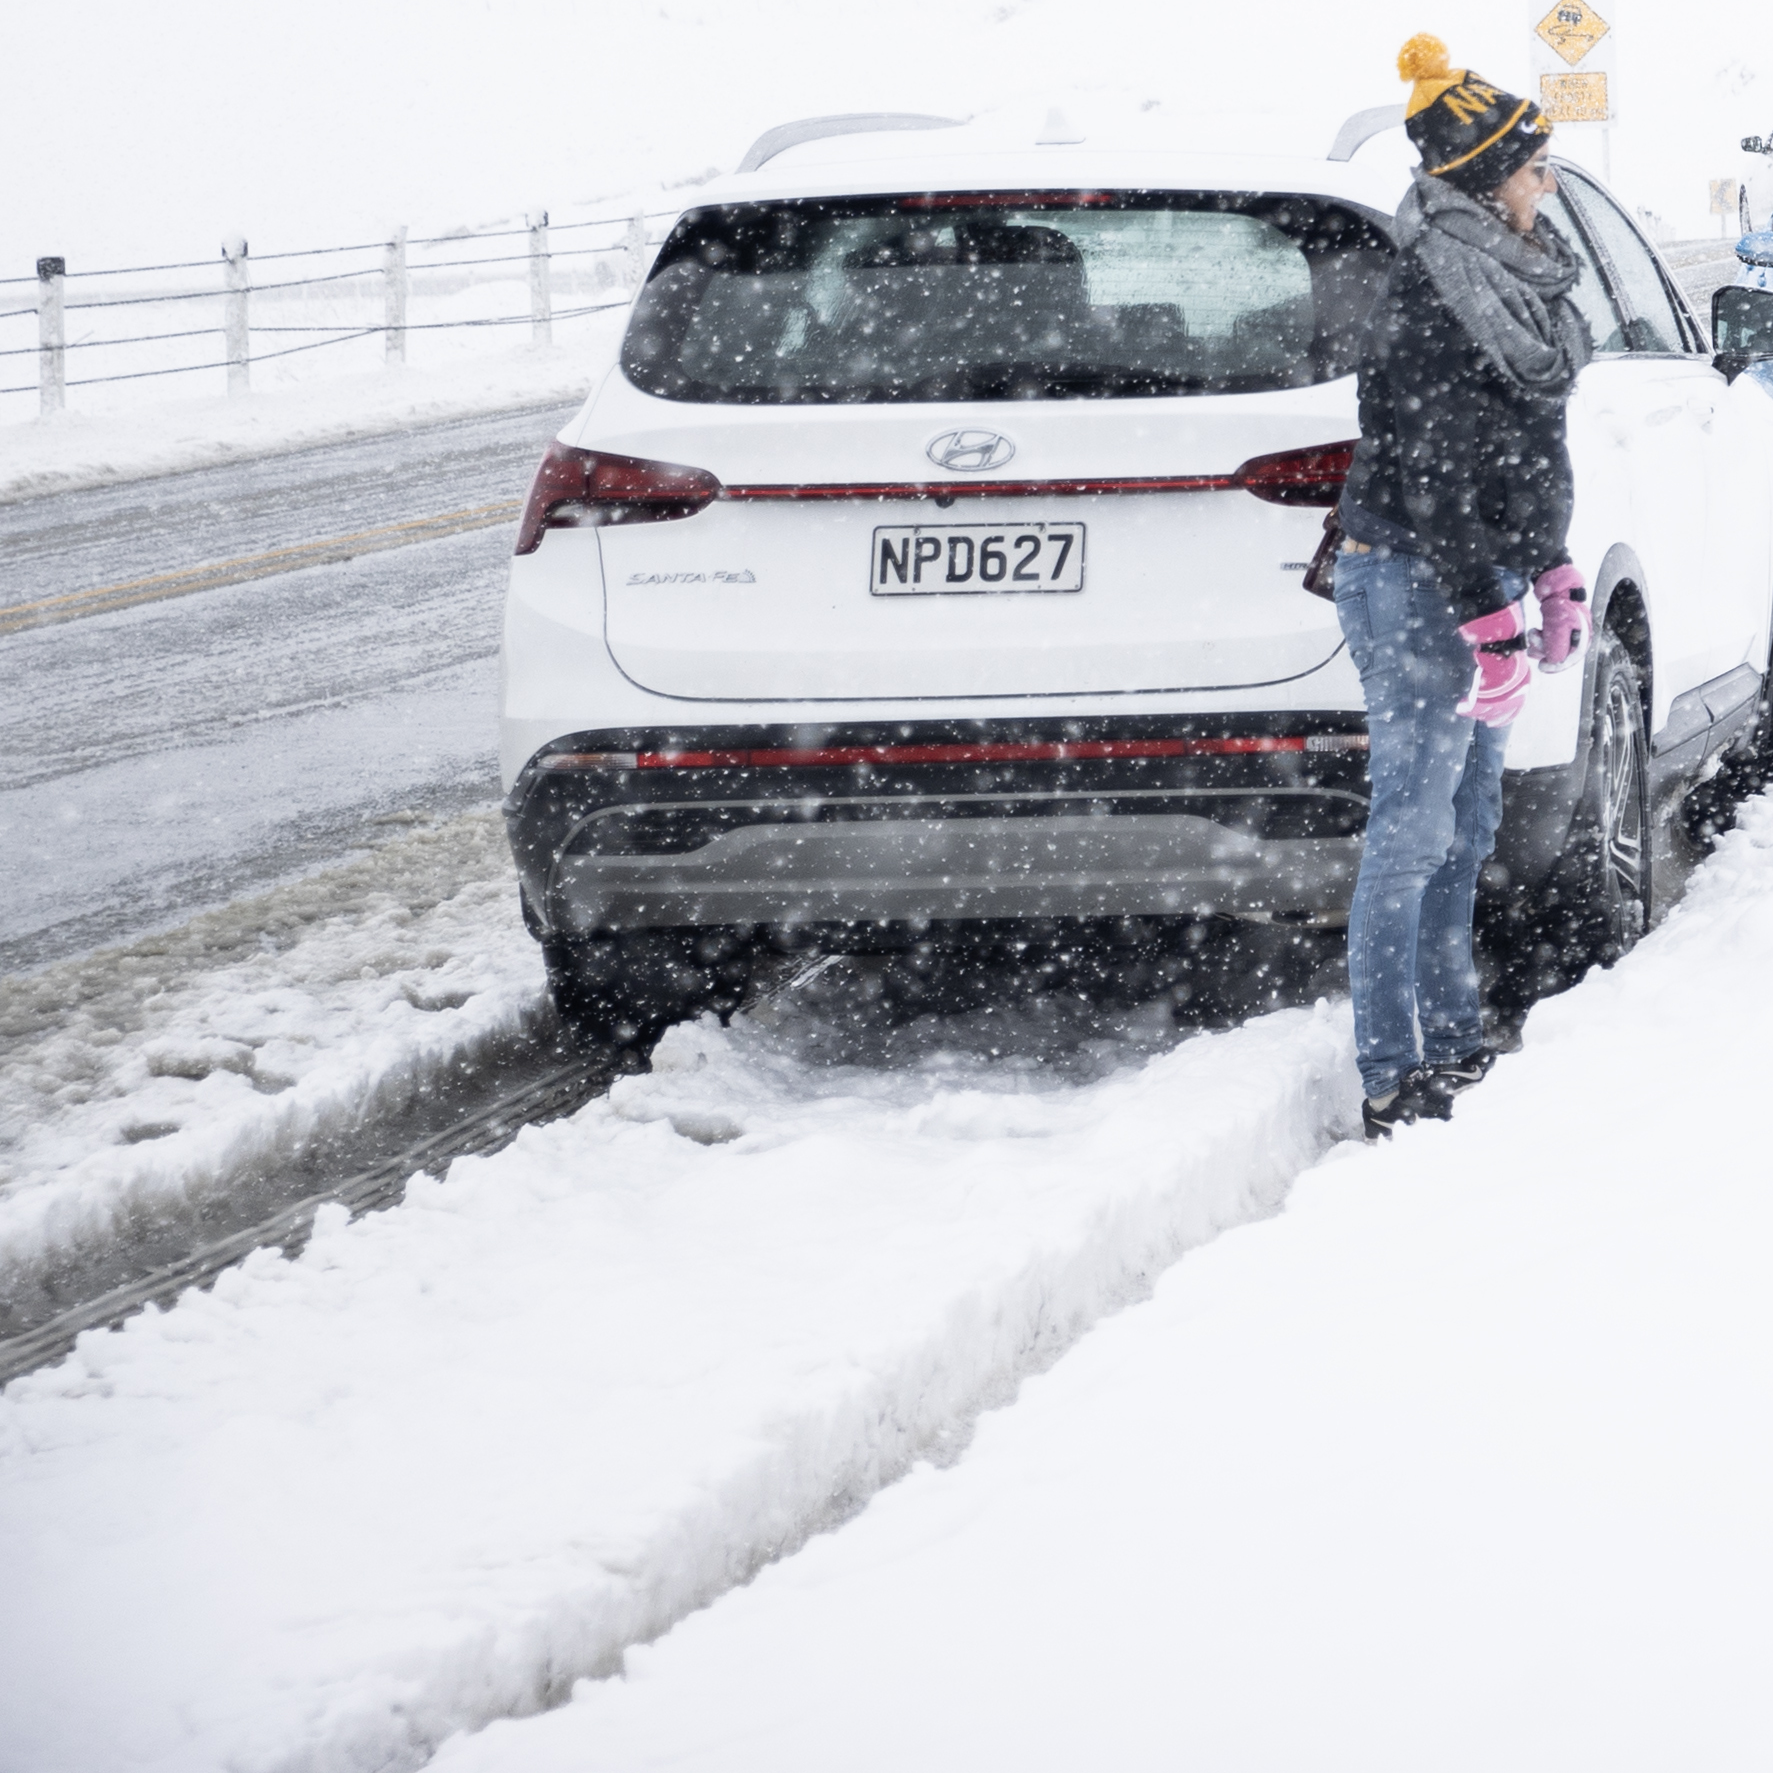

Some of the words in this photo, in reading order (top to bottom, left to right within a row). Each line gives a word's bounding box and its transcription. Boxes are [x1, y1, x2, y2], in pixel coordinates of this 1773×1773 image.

[880, 534, 1074, 584] NPD627
[626, 572, 706, 586] SANTA
[713, 571, 741, 583] FE
